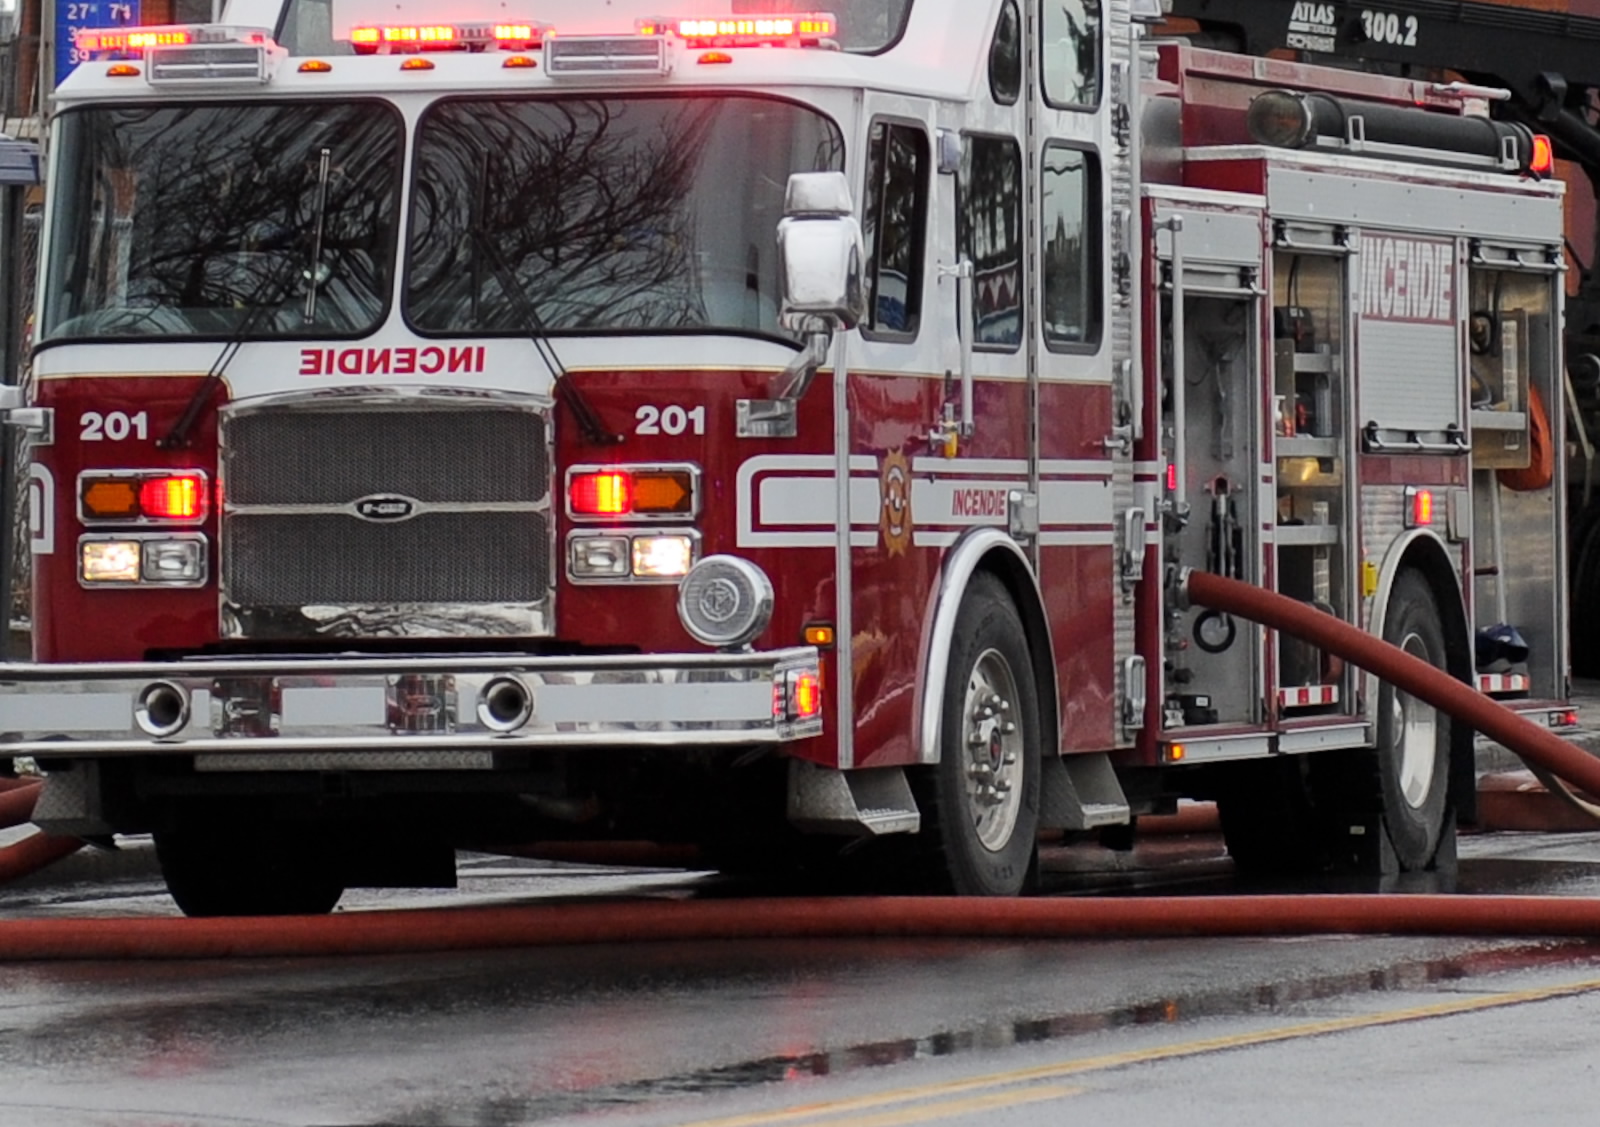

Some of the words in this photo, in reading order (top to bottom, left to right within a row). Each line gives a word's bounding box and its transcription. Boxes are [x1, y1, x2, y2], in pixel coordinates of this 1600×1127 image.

[1290, 1, 1336, 25] ATLAS
[1360, 237, 1454, 320] INCENDIE
[80, 410, 147, 441] 201
[635, 404, 705, 436] 201
[952, 488, 1006, 517] INCENDIE
